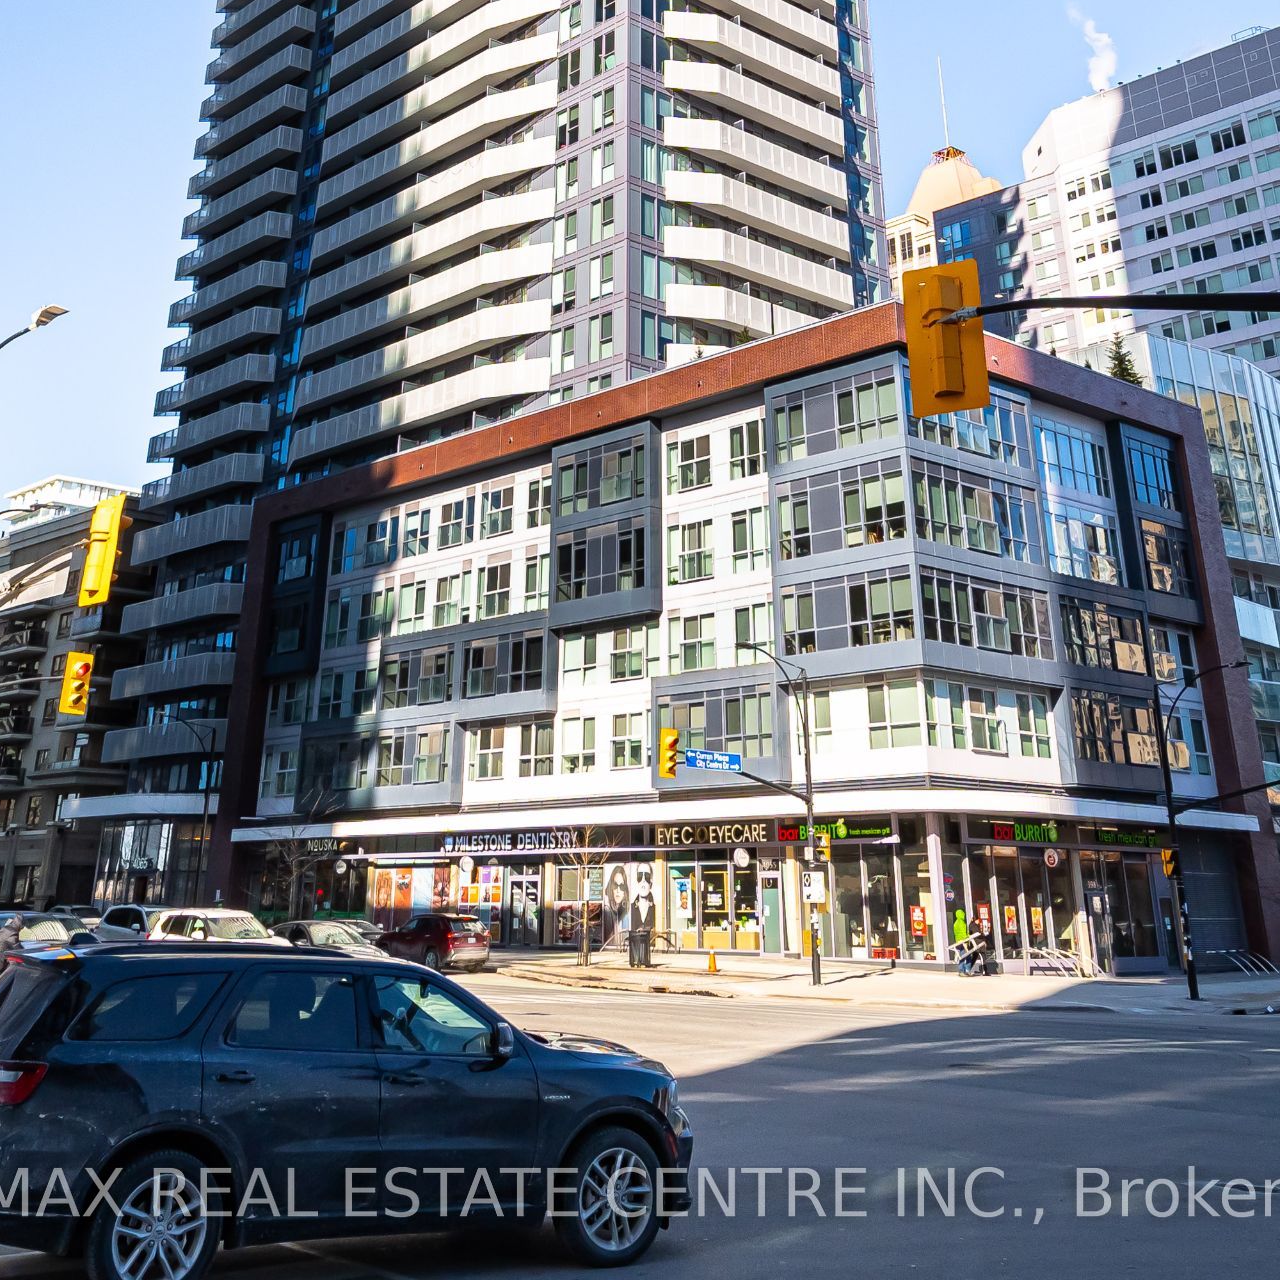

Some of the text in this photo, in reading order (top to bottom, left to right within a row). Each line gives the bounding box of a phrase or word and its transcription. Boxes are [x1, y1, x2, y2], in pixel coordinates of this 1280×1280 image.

[455, 831, 578, 852] MILESTONE DENTISTRY
[657, 828, 679, 845] EYE
[709, 823, 768, 844] EYECARE
